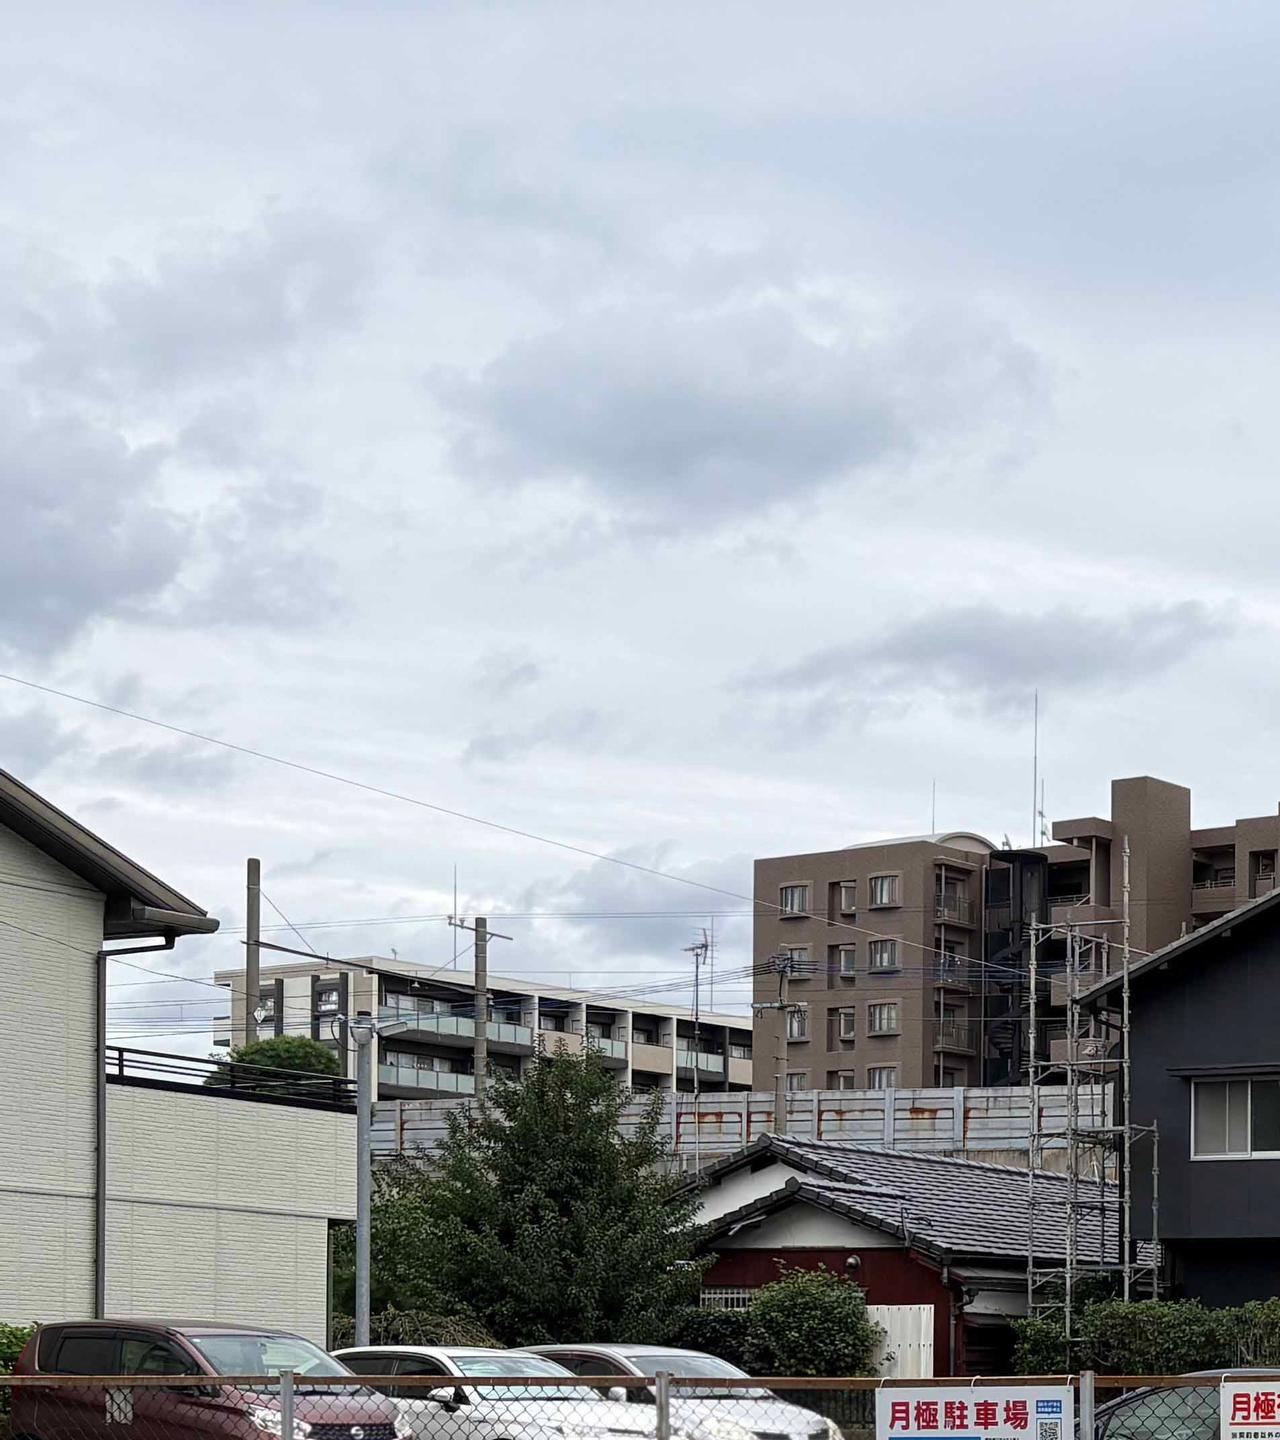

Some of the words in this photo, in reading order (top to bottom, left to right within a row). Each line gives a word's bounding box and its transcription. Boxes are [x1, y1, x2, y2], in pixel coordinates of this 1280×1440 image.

[888, 1400, 1030, 1431] 月極駐車場
